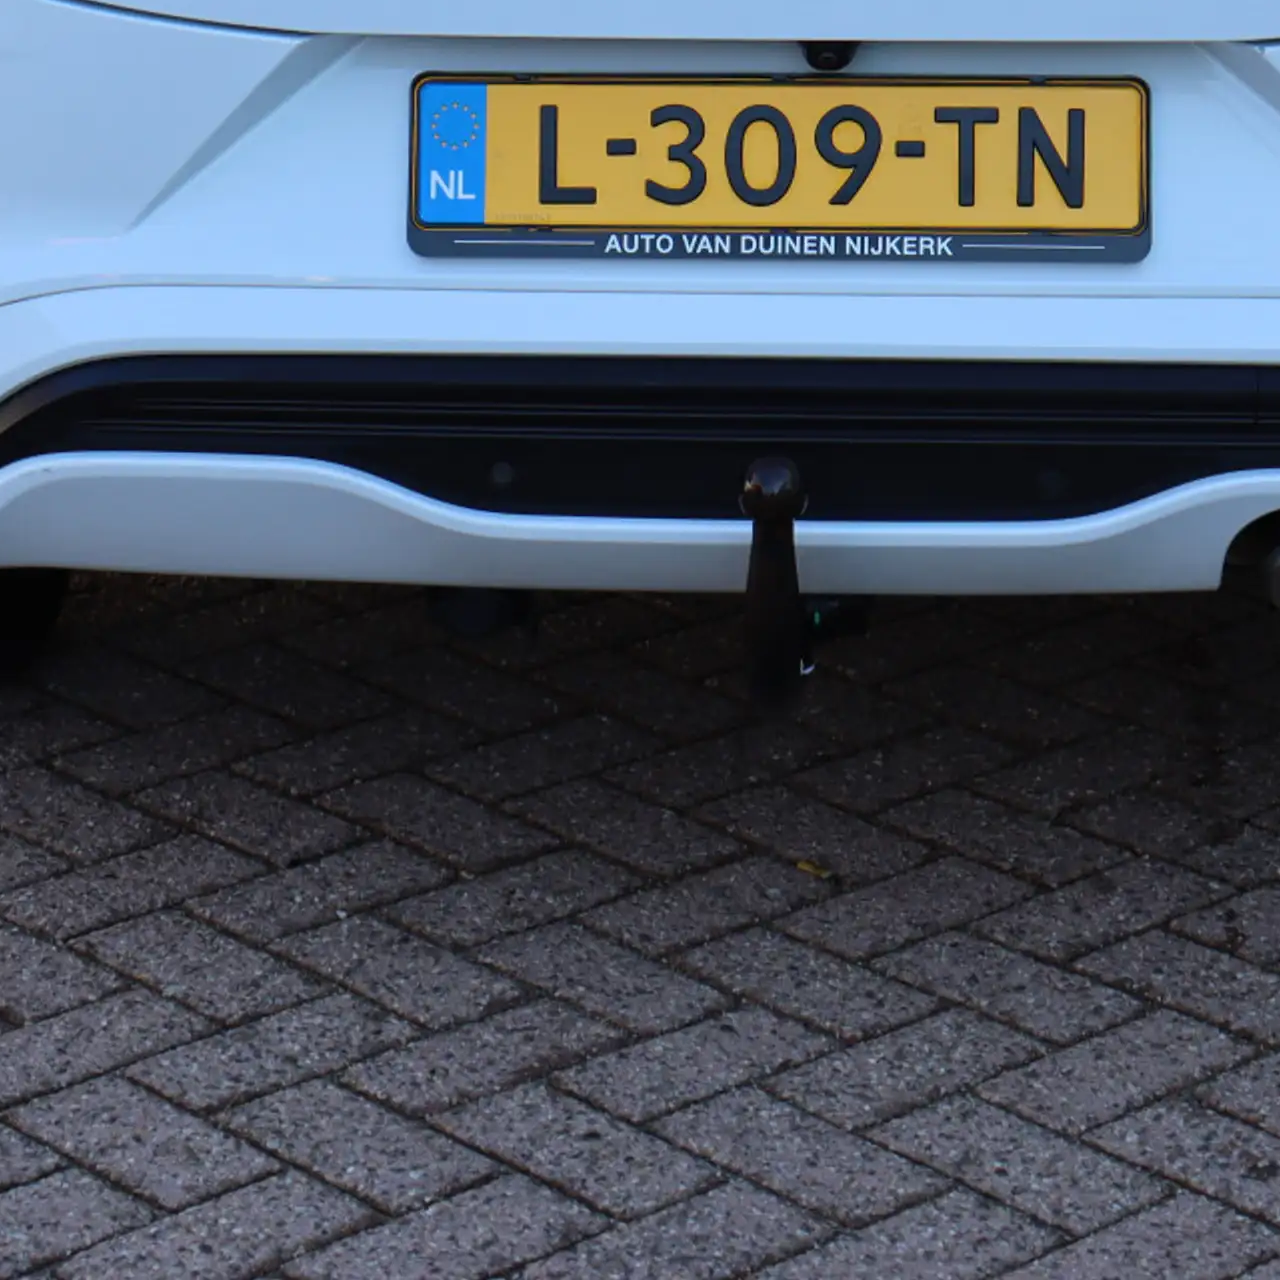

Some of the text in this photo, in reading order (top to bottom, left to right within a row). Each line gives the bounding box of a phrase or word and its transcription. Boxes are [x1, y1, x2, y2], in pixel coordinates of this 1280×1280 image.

[429, 103, 1086, 208] NL L-309-TN
[604, 234, 953, 256] AUTO VAN DUINEN NIJKERK
